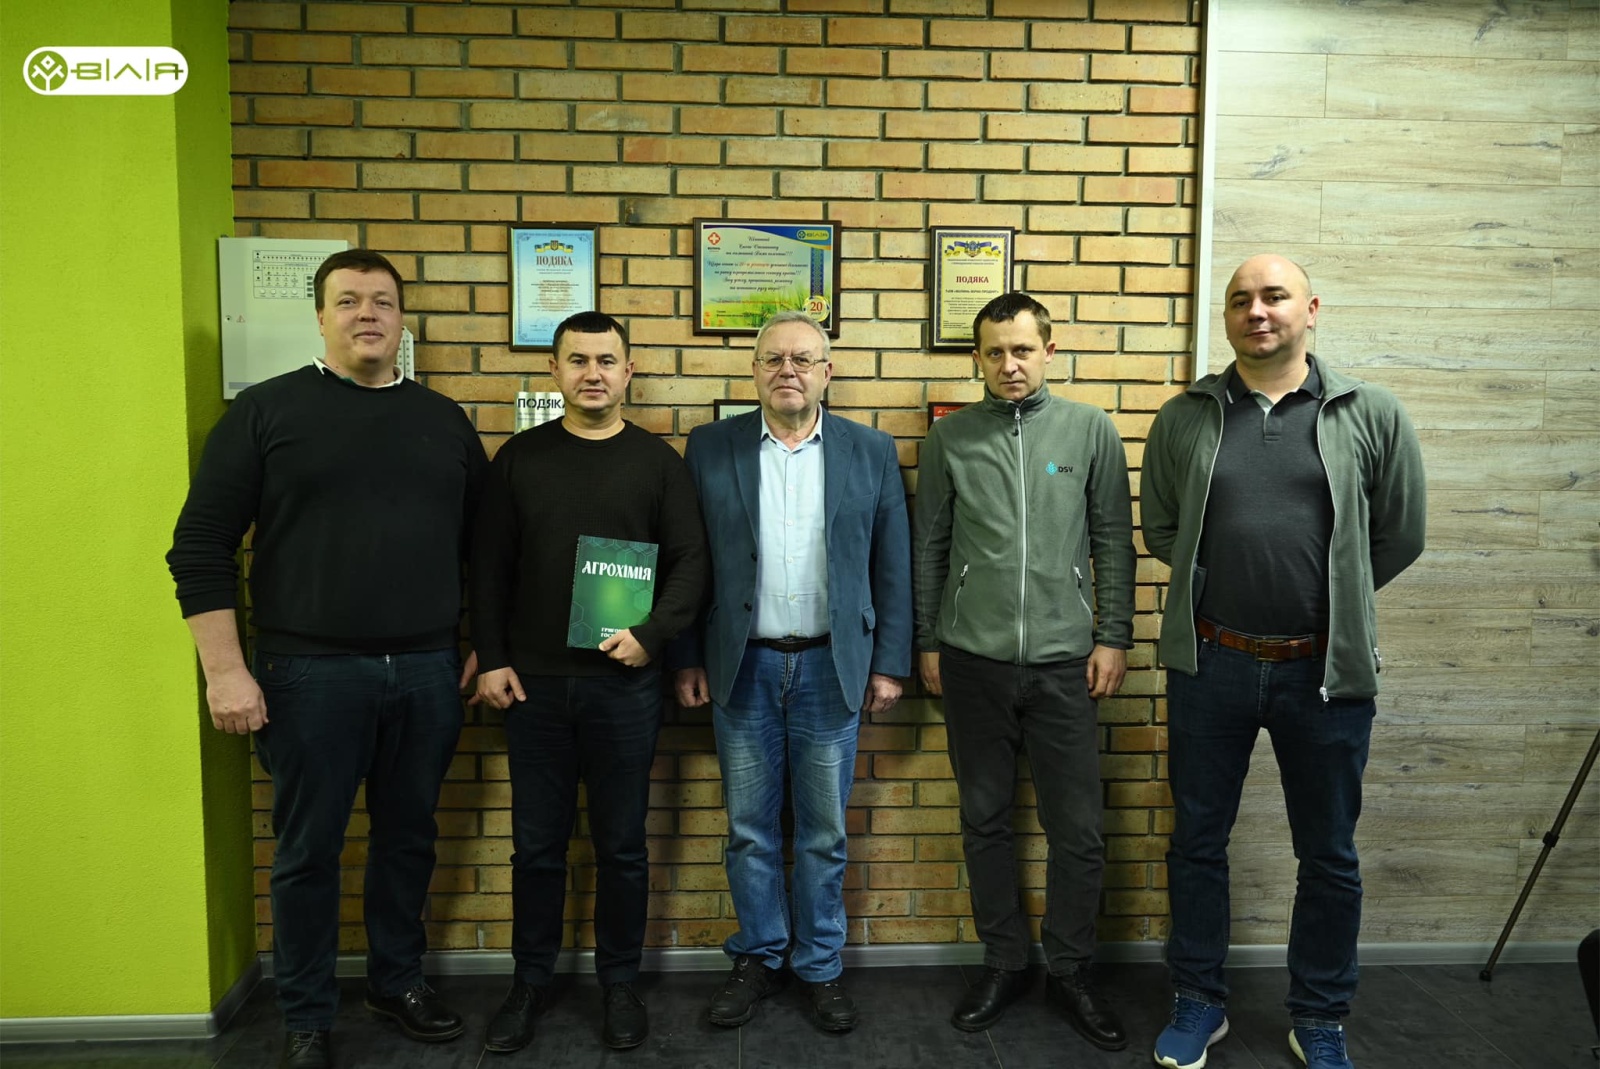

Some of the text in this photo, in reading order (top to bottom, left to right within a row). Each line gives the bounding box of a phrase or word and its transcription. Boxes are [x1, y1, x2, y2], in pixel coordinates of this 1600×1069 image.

[536, 255, 573, 268] ПОДЯКА
[956, 276, 989, 284] ПОДЯКА
[810, 301, 823, 312] 20
[582, 561, 651, 581] АГРОХІМІЯ
